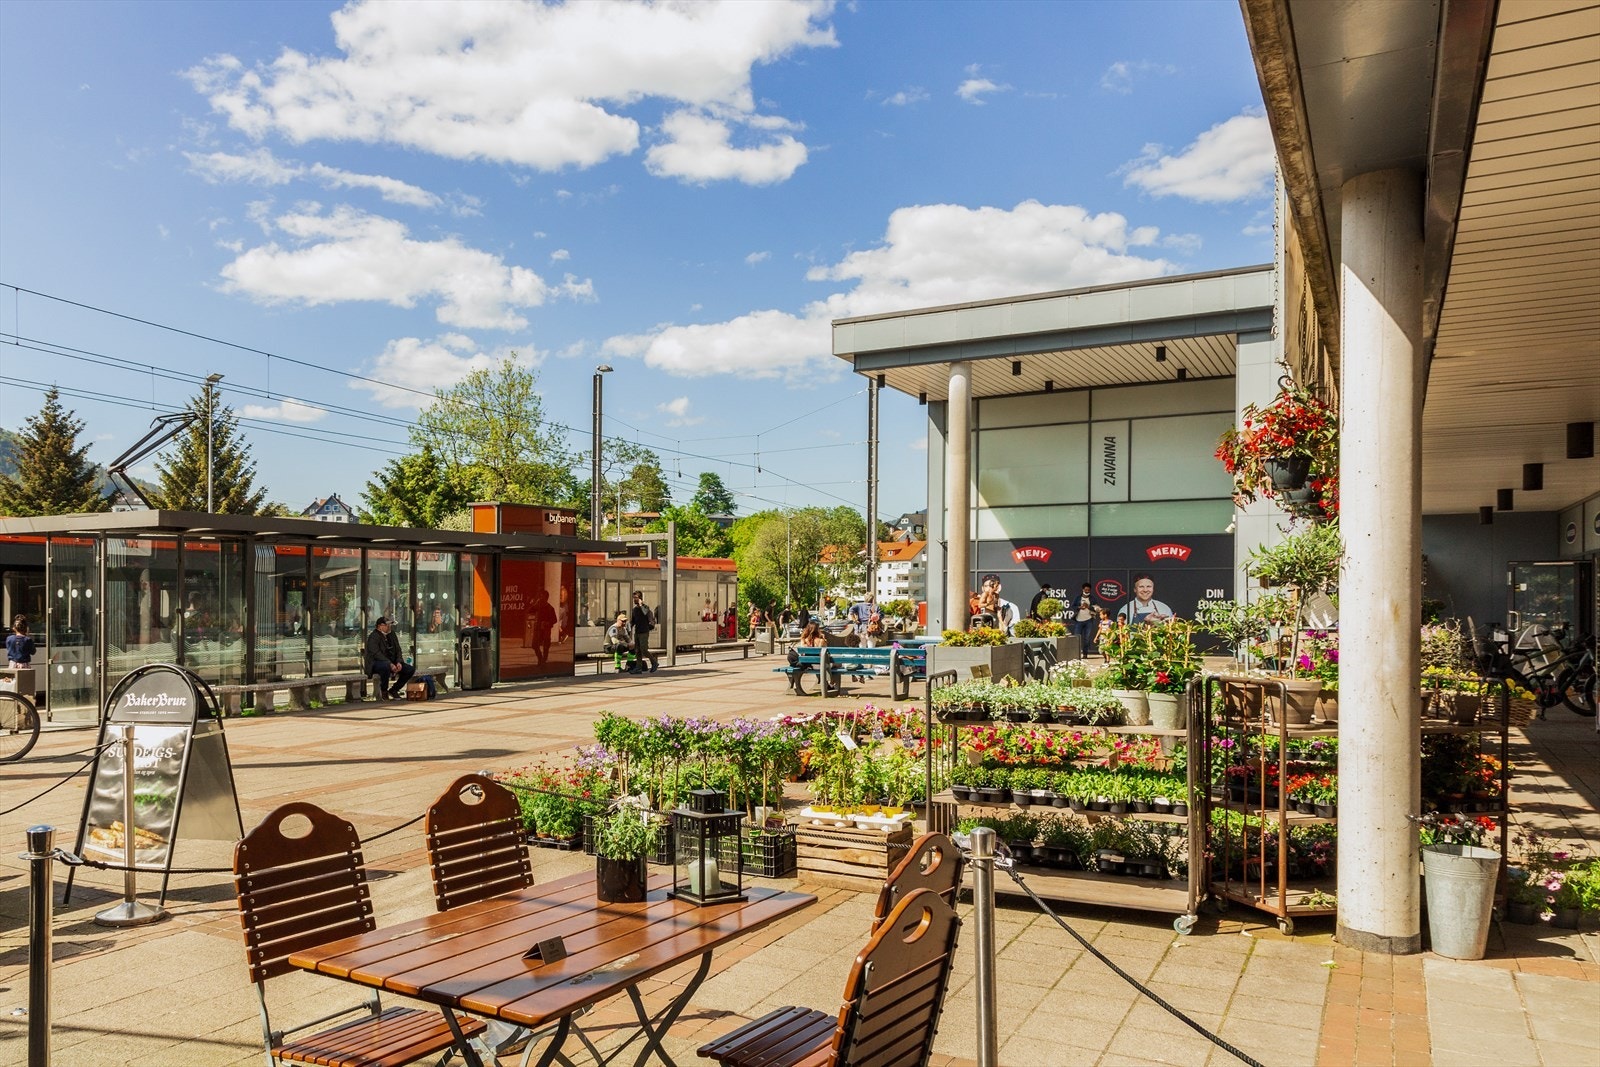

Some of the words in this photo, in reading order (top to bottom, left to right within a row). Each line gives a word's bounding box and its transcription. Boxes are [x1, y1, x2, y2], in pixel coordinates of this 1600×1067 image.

[1103, 436, 1116, 486] ZAVANNA
[549, 512, 577, 525] bybanen
[1015, 549, 1048, 560] MENY
[1151, 546, 1187, 558] MENY
[1206, 589, 1224, 598] DIN
[123, 692, 187, 708] BakerBrun
[108, 746, 177, 759] SUDEIGS-
